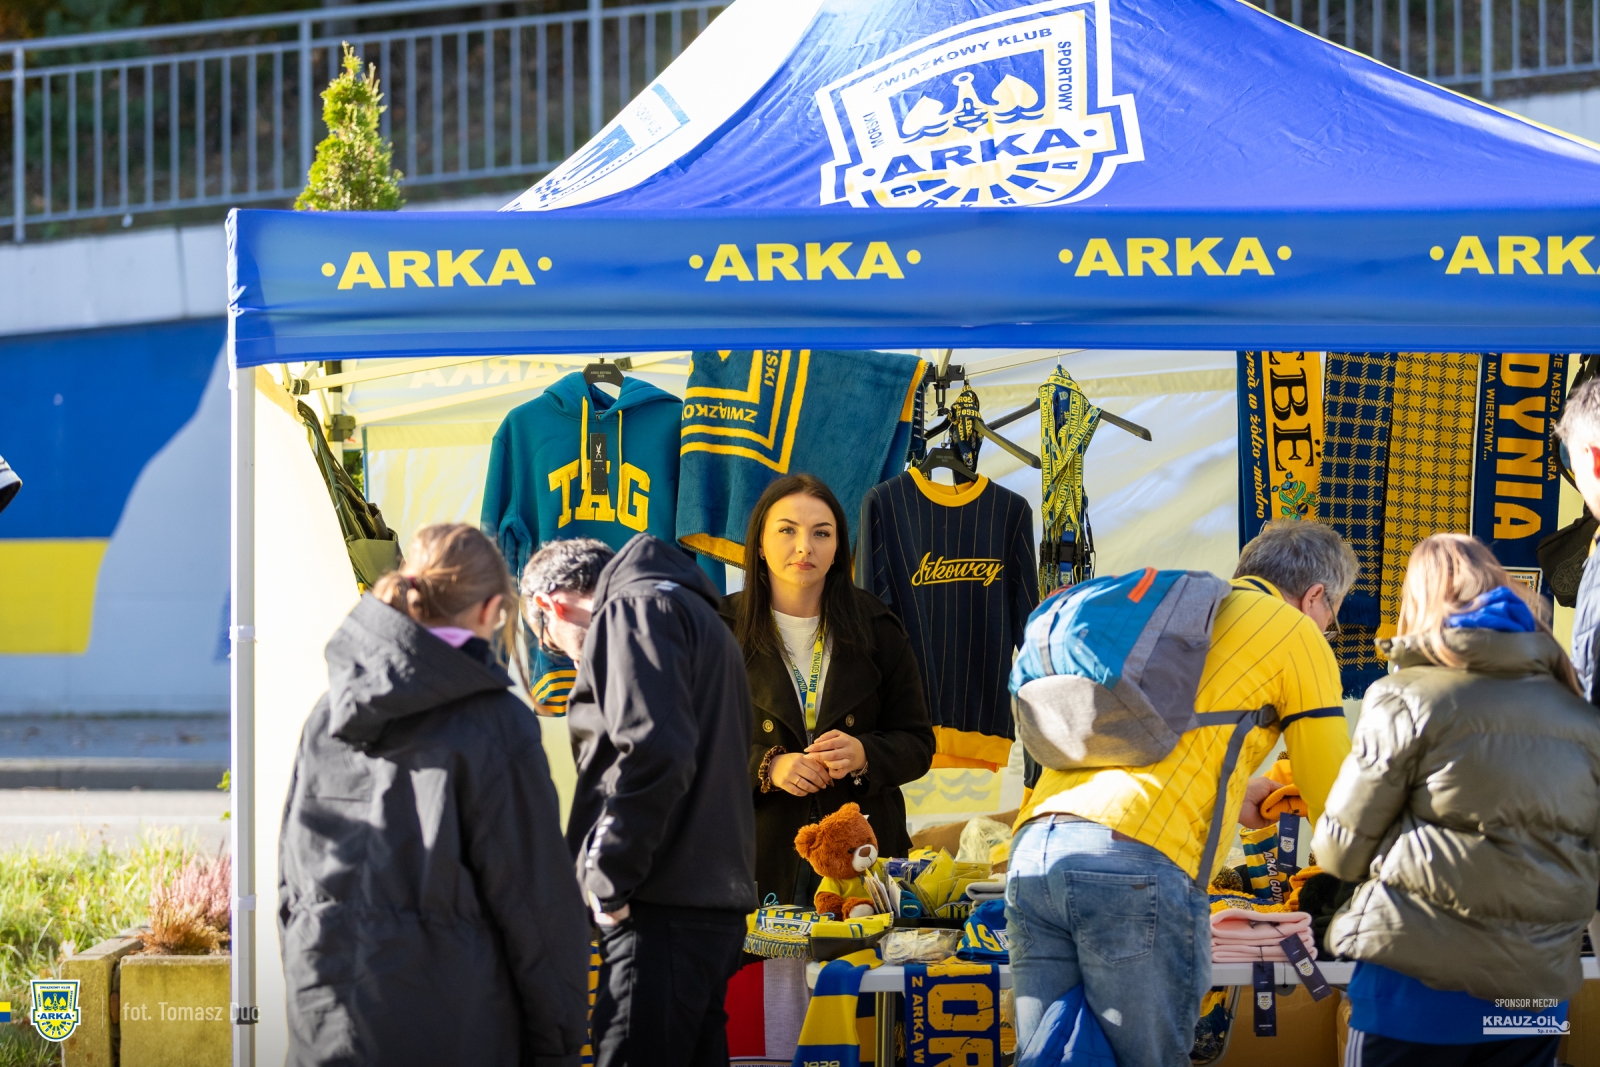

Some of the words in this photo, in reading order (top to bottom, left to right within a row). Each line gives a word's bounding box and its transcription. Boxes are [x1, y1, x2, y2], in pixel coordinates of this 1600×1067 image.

[997, 27, 1053, 47] KLUB
[1057, 40, 1073, 112] SPORTOWY
[862, 111, 885, 149] MORSKI
[880, 127, 1081, 183] ARKA
[337, 248, 536, 290] ARKA
[704, 241, 905, 282] ARKA
[1074, 237, 1275, 277] ARKA
[1444, 235, 1600, 275] ARK
[764, 350, 779, 387] SKI
[1550, 372, 1562, 412] NASZA
[682, 402, 758, 423] ZWIĄZKO
[548, 458, 650, 532] TAG
[809, 673, 819, 693] ARKA
[1263, 851, 1278, 876] ARKA
